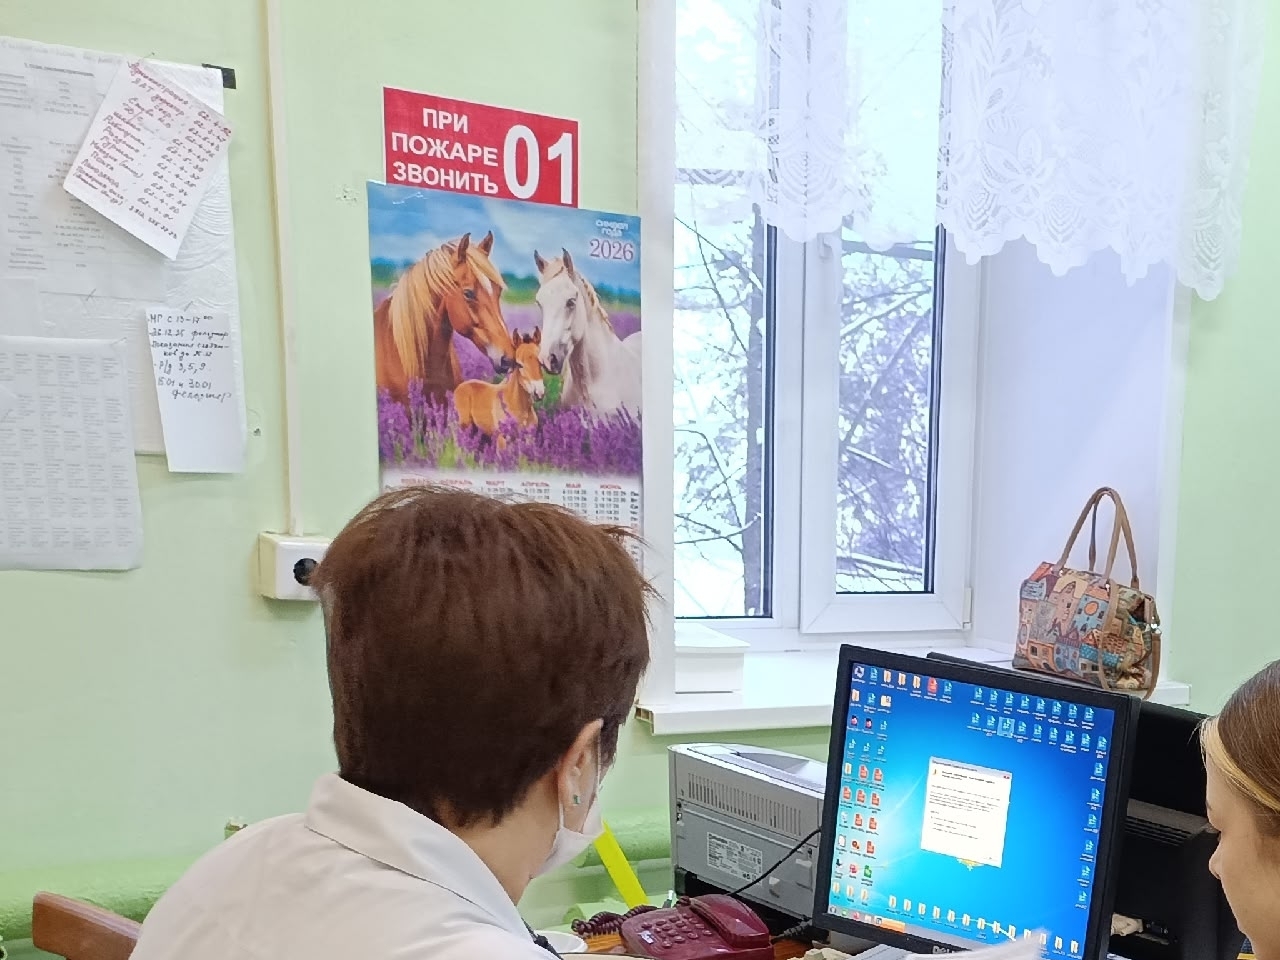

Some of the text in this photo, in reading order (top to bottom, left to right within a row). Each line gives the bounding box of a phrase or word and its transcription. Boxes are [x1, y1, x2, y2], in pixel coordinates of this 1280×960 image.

[422, 108, 469, 134] ПРИ
[391, 132, 499, 167] ПОЖАРЕ
[503, 124, 573, 205] 01
[392, 161, 499, 194] ЗВОНИТЬ
[589, 238, 634, 261] 2026
